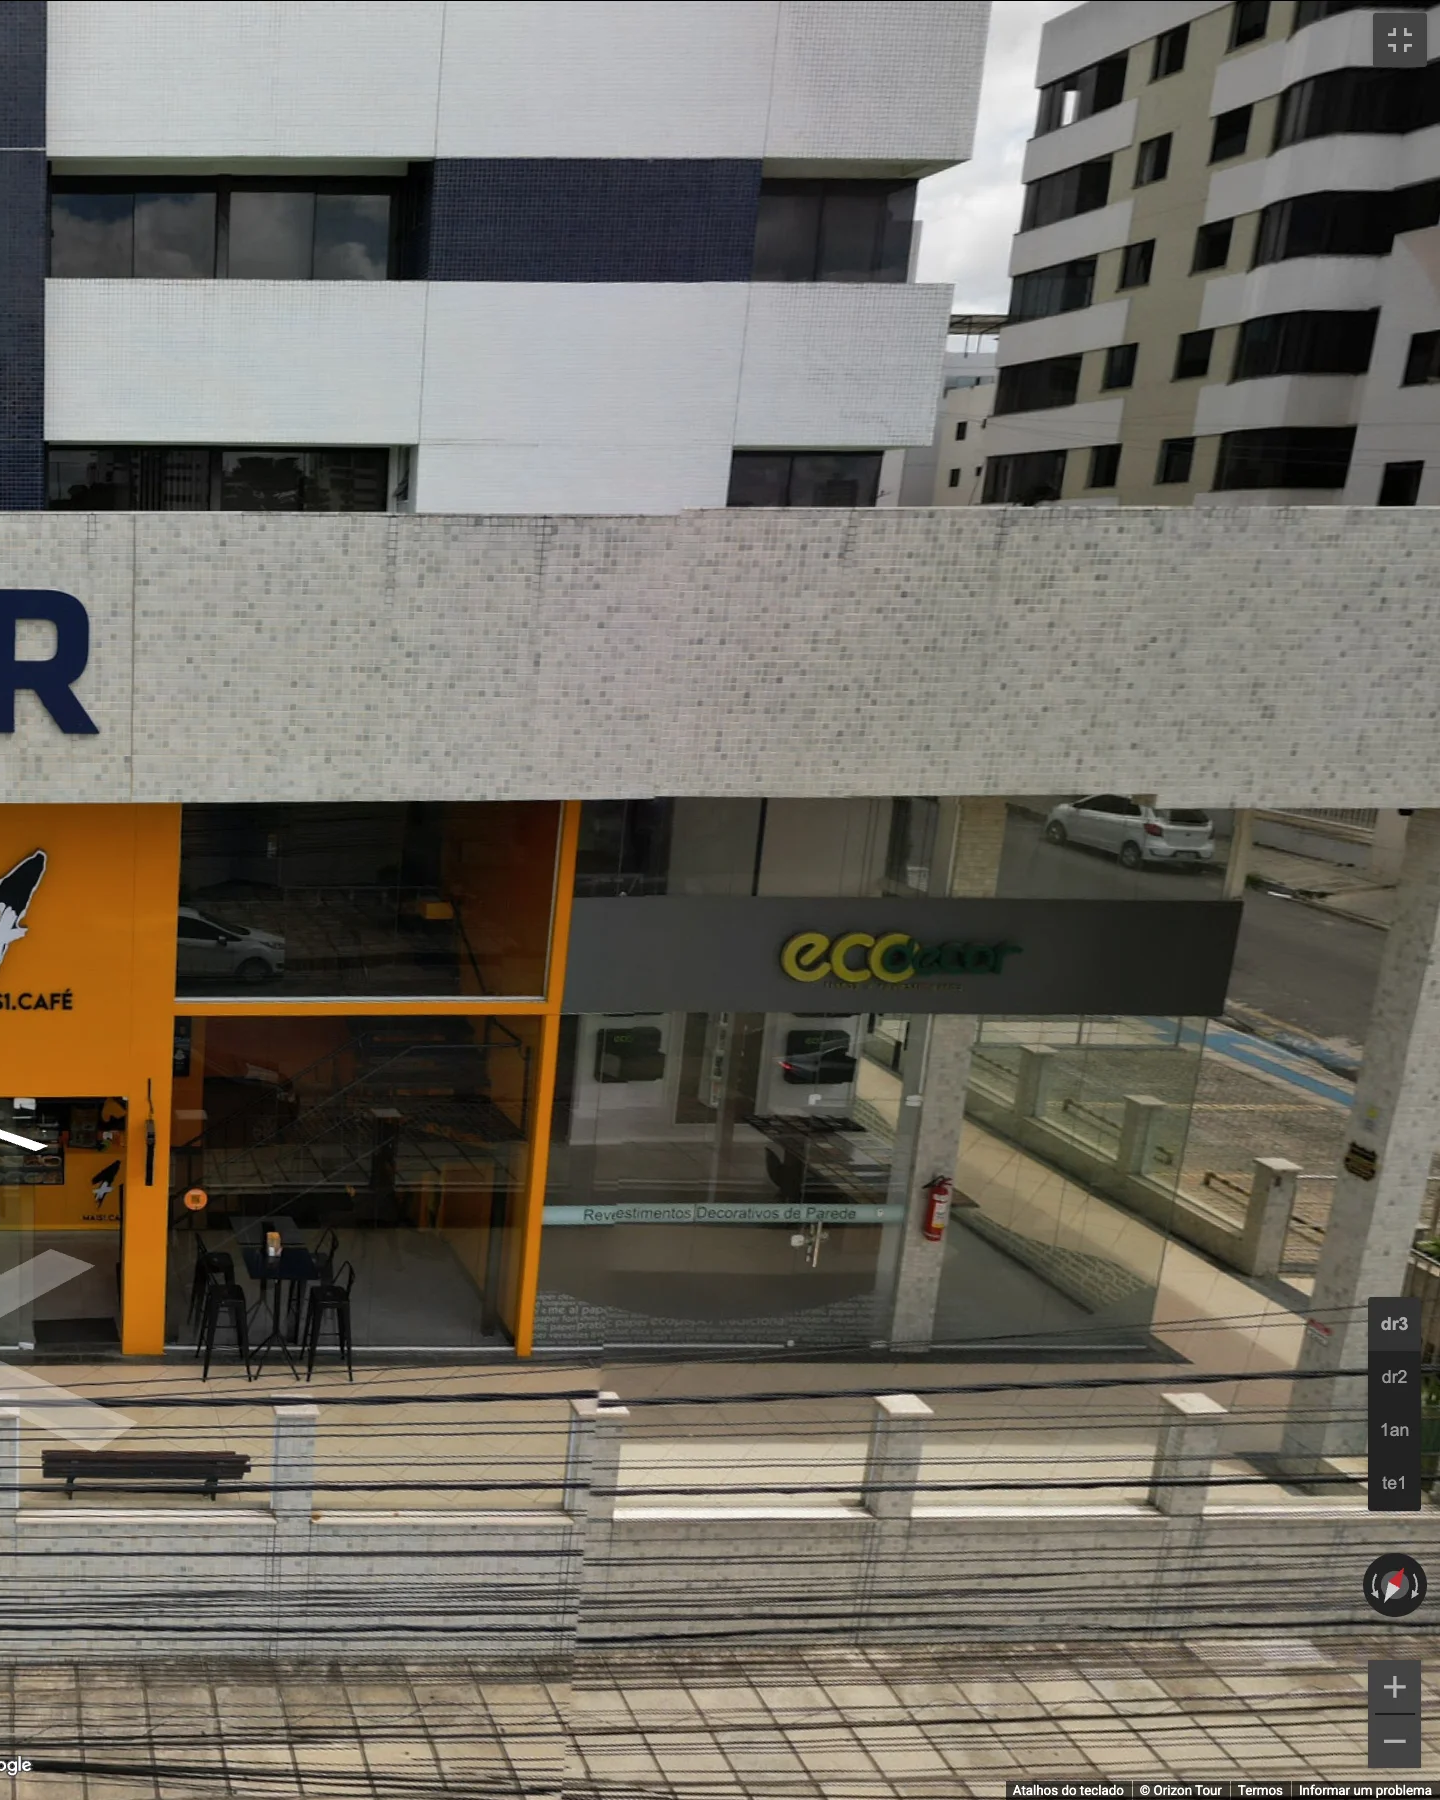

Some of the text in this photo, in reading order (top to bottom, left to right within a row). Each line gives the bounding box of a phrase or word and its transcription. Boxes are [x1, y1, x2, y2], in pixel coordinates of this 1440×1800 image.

[696, 1206, 780, 1219] Decorativos
[783, 1206, 801, 1219] de
[805, 1206, 857, 1219] Parede
[82, 1214, 121, 1222] MAIS1.CA
